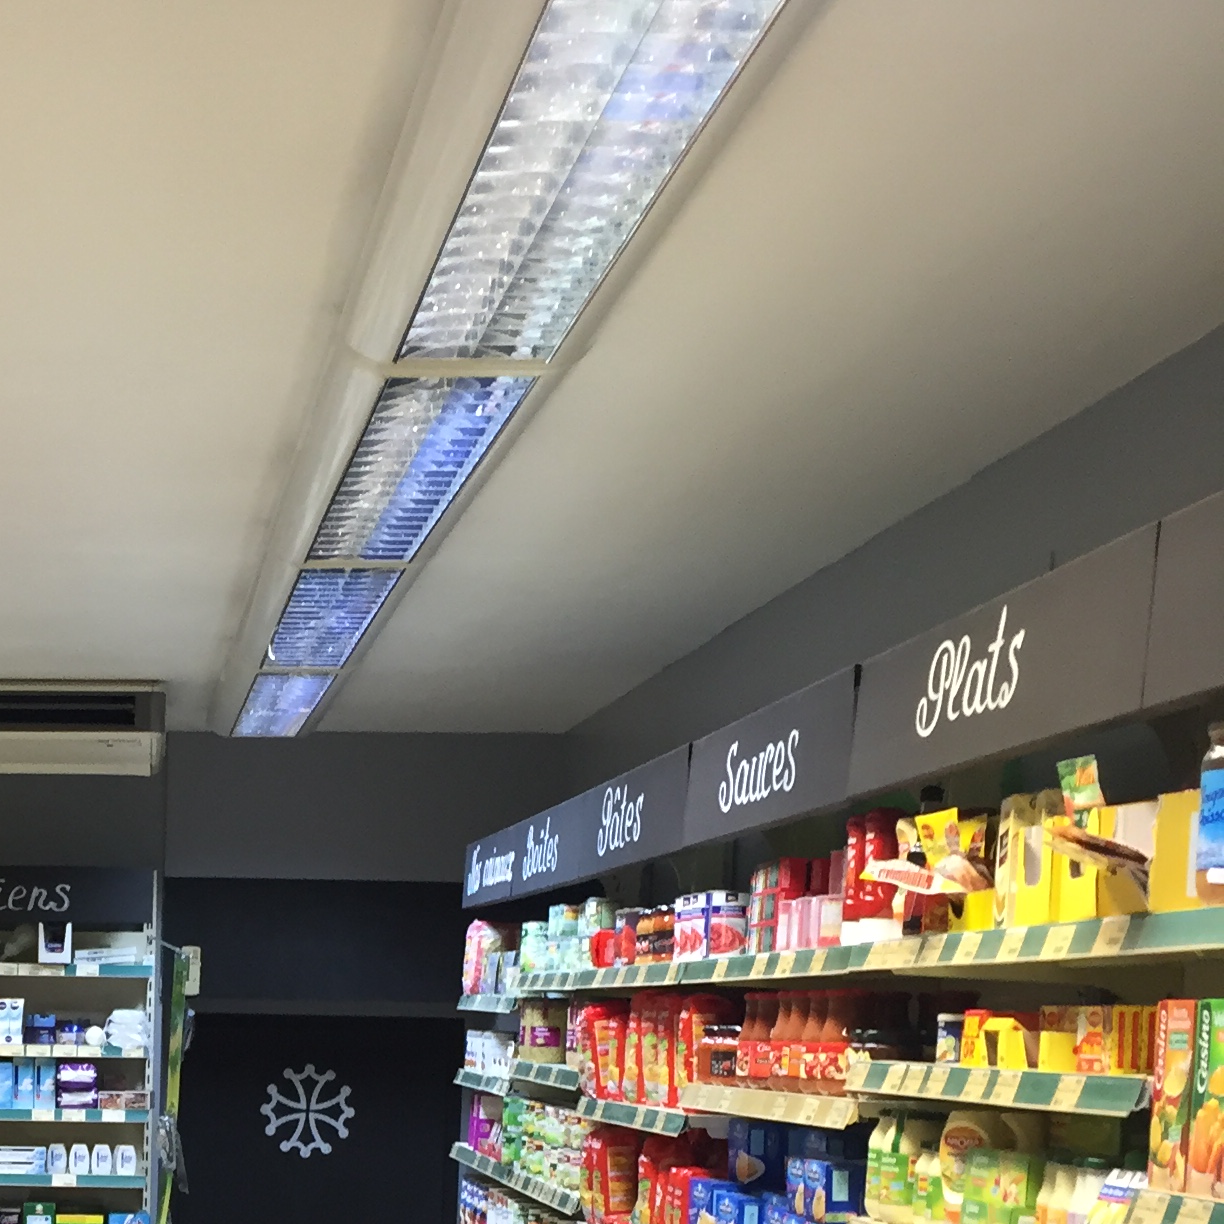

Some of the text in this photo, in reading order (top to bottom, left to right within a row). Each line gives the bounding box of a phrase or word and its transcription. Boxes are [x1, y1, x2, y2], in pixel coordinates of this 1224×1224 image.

[916, 605, 1025, 738] Plats
[719, 729, 800, 814] Sauces
[597, 785, 644, 856] Pâtes
[1154, 1009, 1167, 1090] Casino
[1197, 1009, 1210, 1094] Casino
